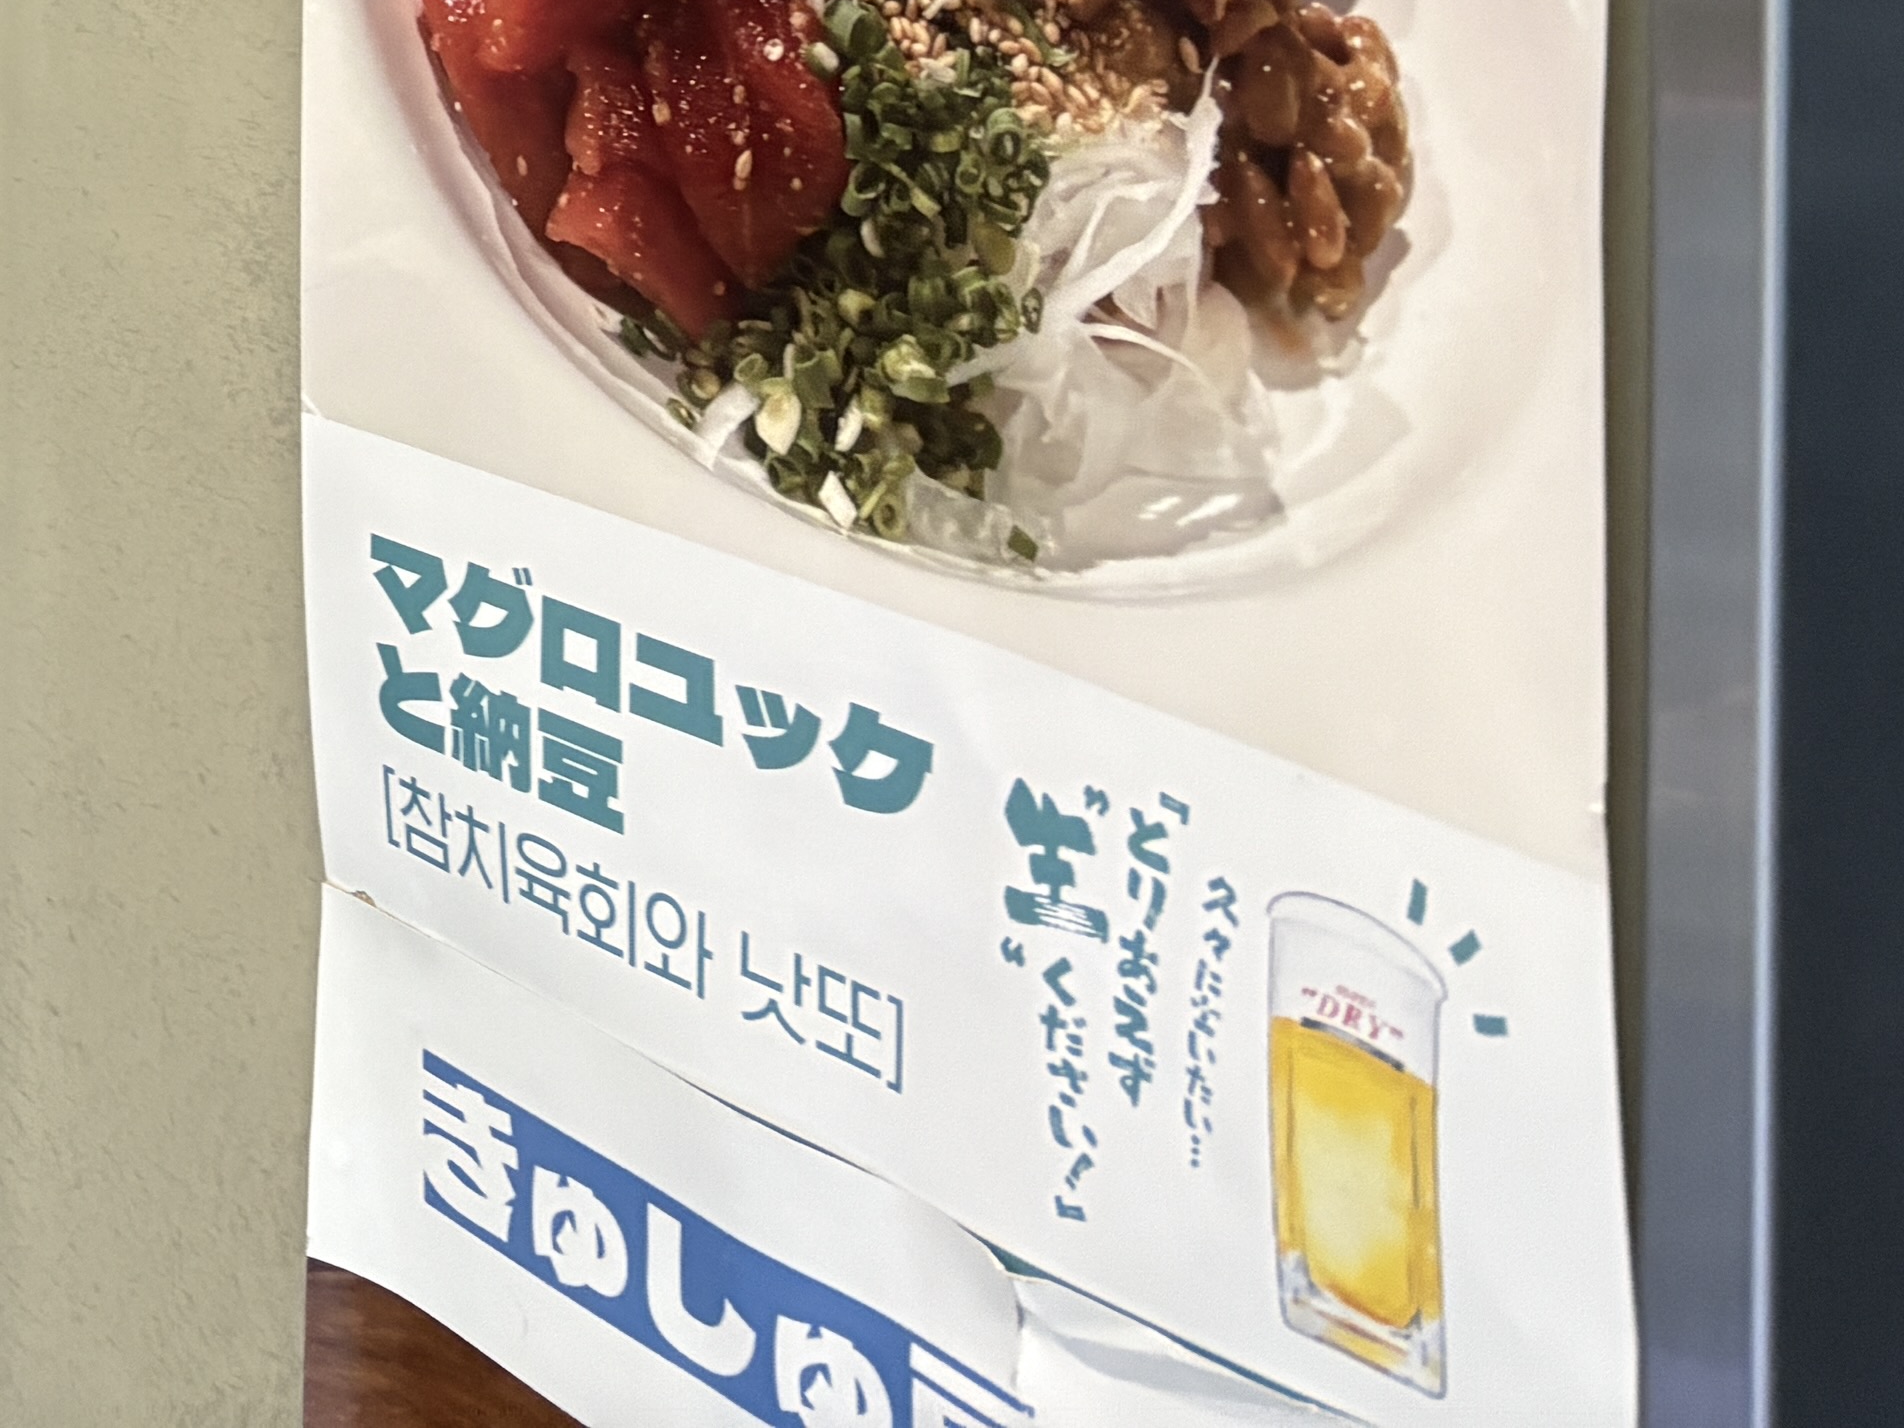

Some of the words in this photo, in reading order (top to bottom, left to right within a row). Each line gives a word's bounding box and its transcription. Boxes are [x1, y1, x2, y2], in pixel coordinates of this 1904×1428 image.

[370, 532, 934, 815] マグロユッケ
[375, 641, 625, 836] と納豆
[382, 763, 714, 1001] [참치육회와
[739, 930, 904, 1095] 낫또]
